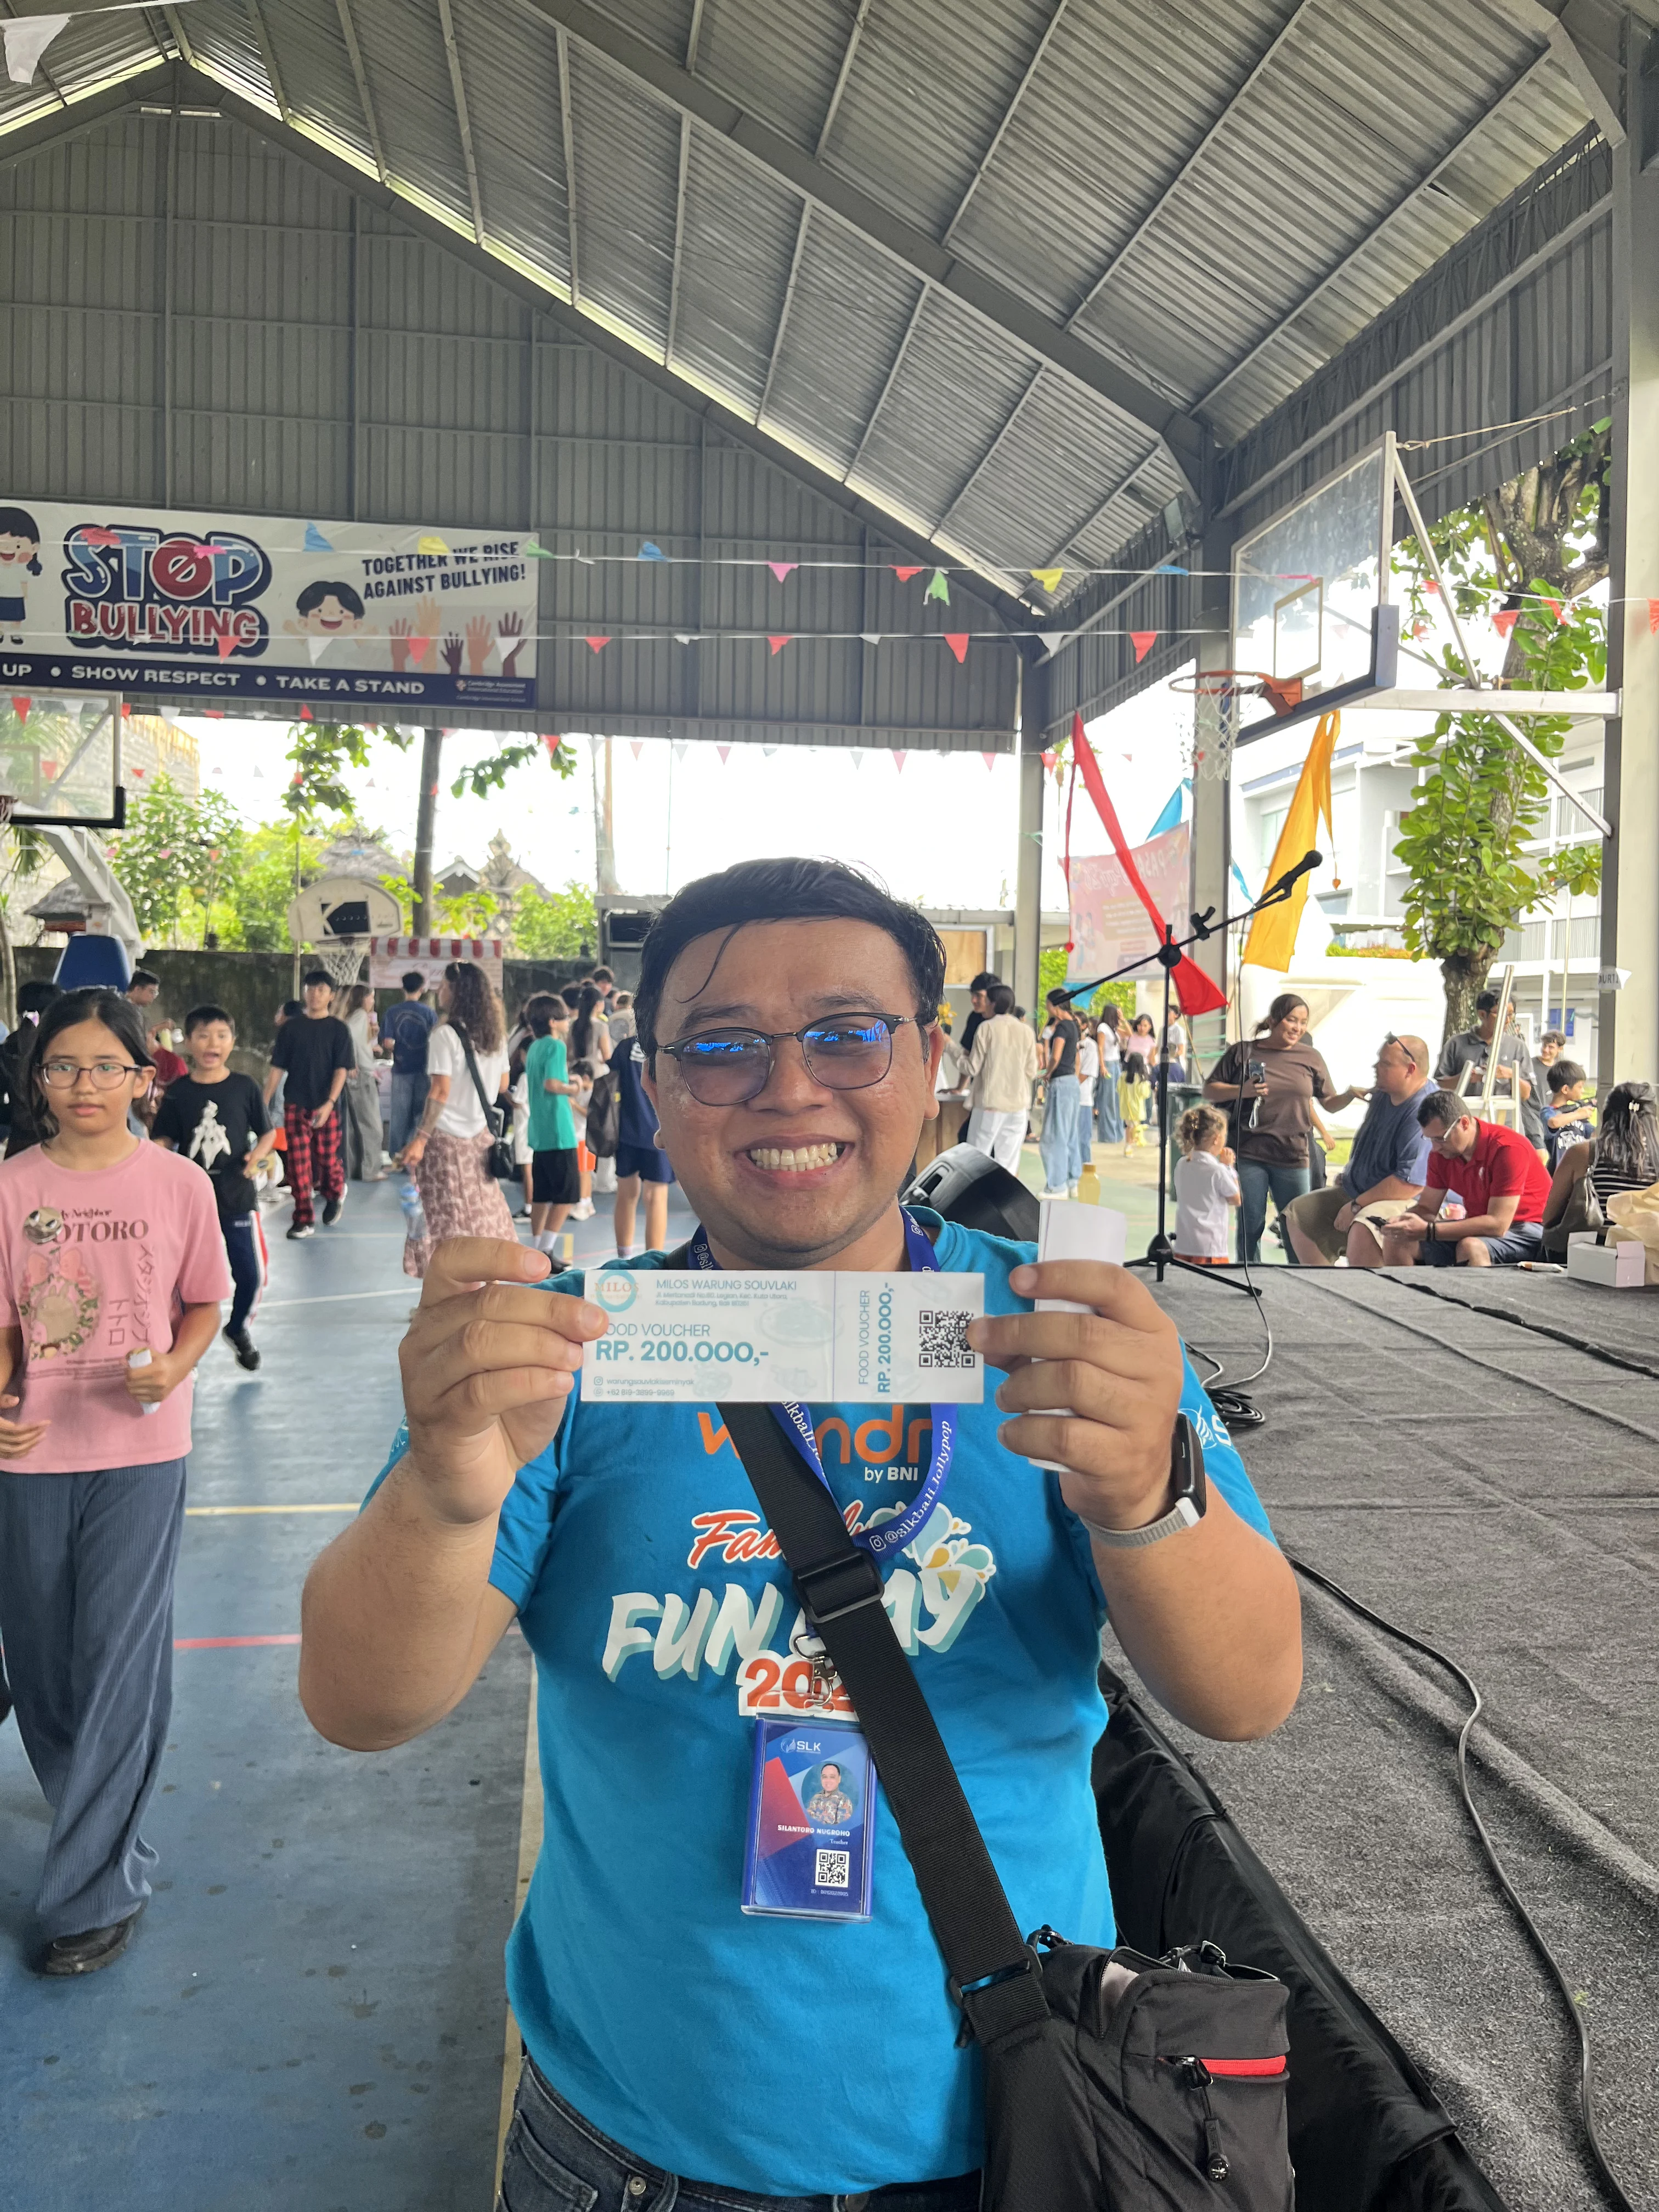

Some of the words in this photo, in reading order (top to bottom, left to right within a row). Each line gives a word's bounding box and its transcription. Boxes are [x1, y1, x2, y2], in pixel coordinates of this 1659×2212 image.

[66, 528, 264, 605] STOP
[362, 554, 448, 576] TOGETHER
[452, 546, 478, 566] WE
[483, 541, 519, 561] RISE
[363, 575, 435, 600] AGAINST
[441, 563, 526, 590] BULLYING!
[70, 599, 261, 648] BULLYING
[2, 663, 32, 677] UP
[71, 665, 139, 681] SHOW
[144, 669, 241, 686] RESPECT
[275, 674, 330, 691] TAKE
[335, 679, 350, 692] A
[354, 679, 425, 695] STAND
[53, 1219, 149, 1244] OTORO
[594, 1282, 639, 1293] MILOS
[656, 1279, 689, 1289] MILOS
[691, 1280, 741, 1290] WARUNG
[744, 1280, 797, 1290] SOUVLAKI
[605, 1323, 637, 1336] OOD
[641, 1323, 710, 1337] VOUCHER
[859, 1290, 870, 1347] VOUCHER
[596, 1340, 635, 1361] RP.
[859, 1350, 869, 1385] FOOD
[877, 1368, 891, 1392] RP.
[864, 1466, 884, 1483] by
[887, 1466, 918, 1481] BNI
[884, 1420, 952, 1543] @slkbali_lollypop
[602, 1582, 785, 1683] FUN
[796, 1740, 821, 1752] SLK
[816, 1828, 850, 1837] NUGROHO
